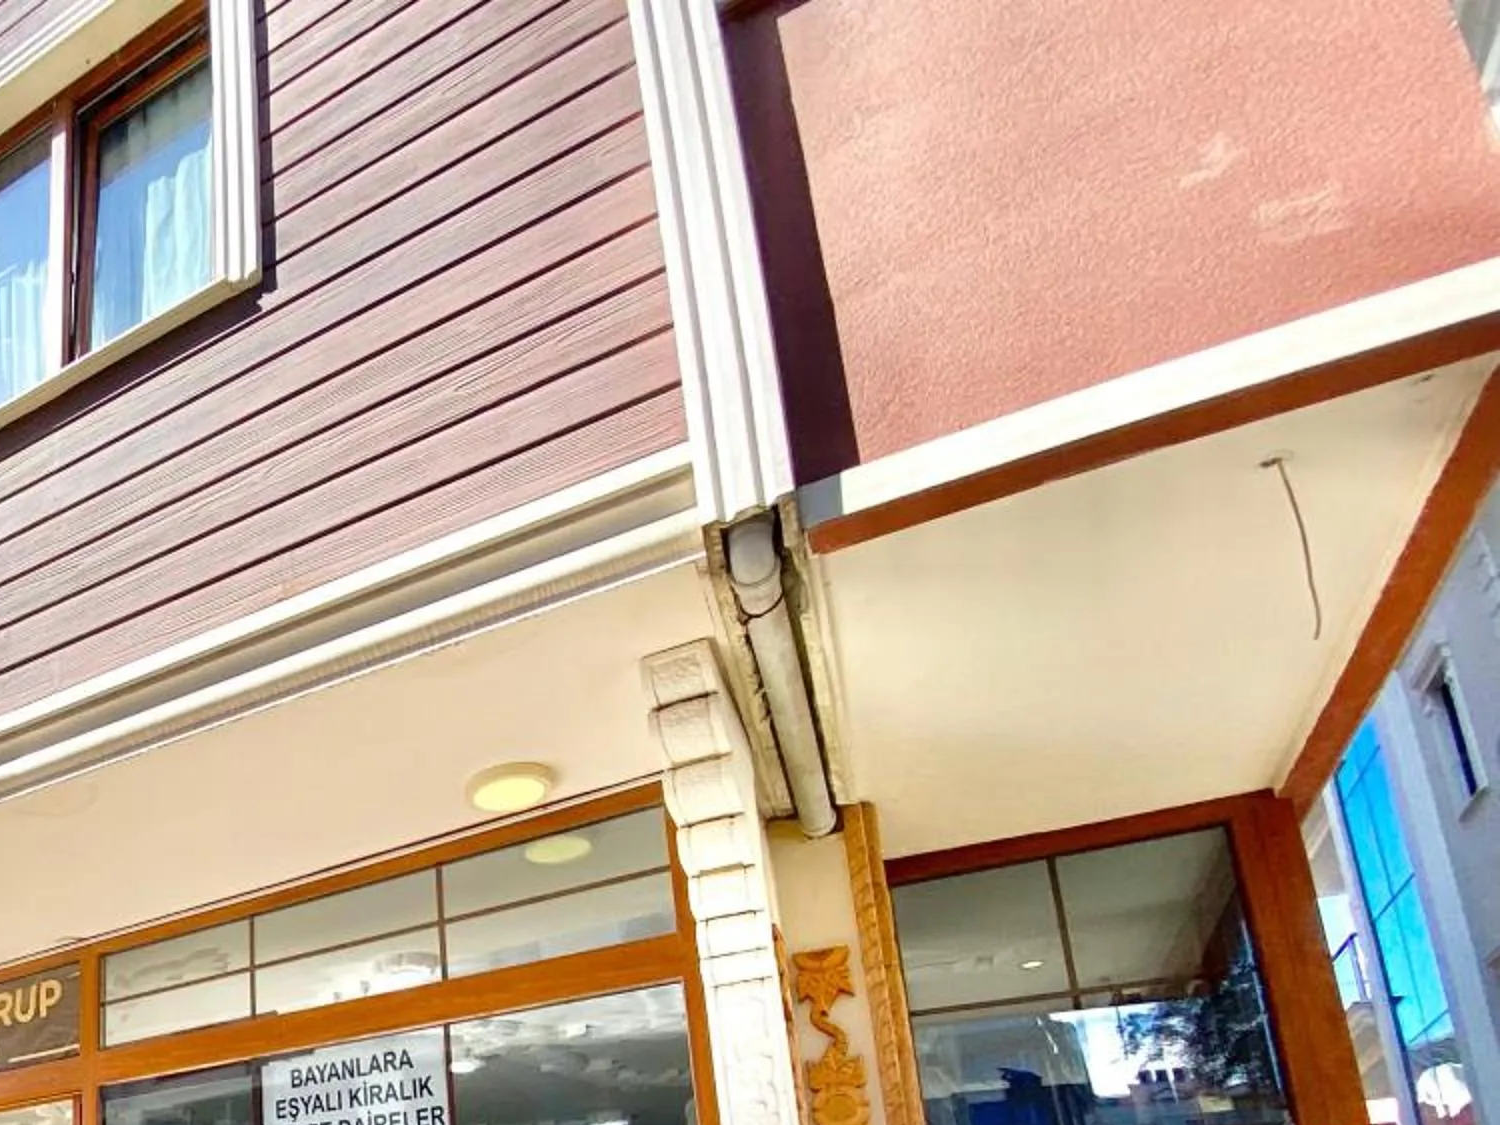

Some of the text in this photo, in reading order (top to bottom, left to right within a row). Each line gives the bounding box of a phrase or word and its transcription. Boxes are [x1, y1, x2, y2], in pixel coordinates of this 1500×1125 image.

[290, 1049, 414, 1088] BAYANLARA
[276, 1075, 434, 1122] EŞYALI KİRALIK
